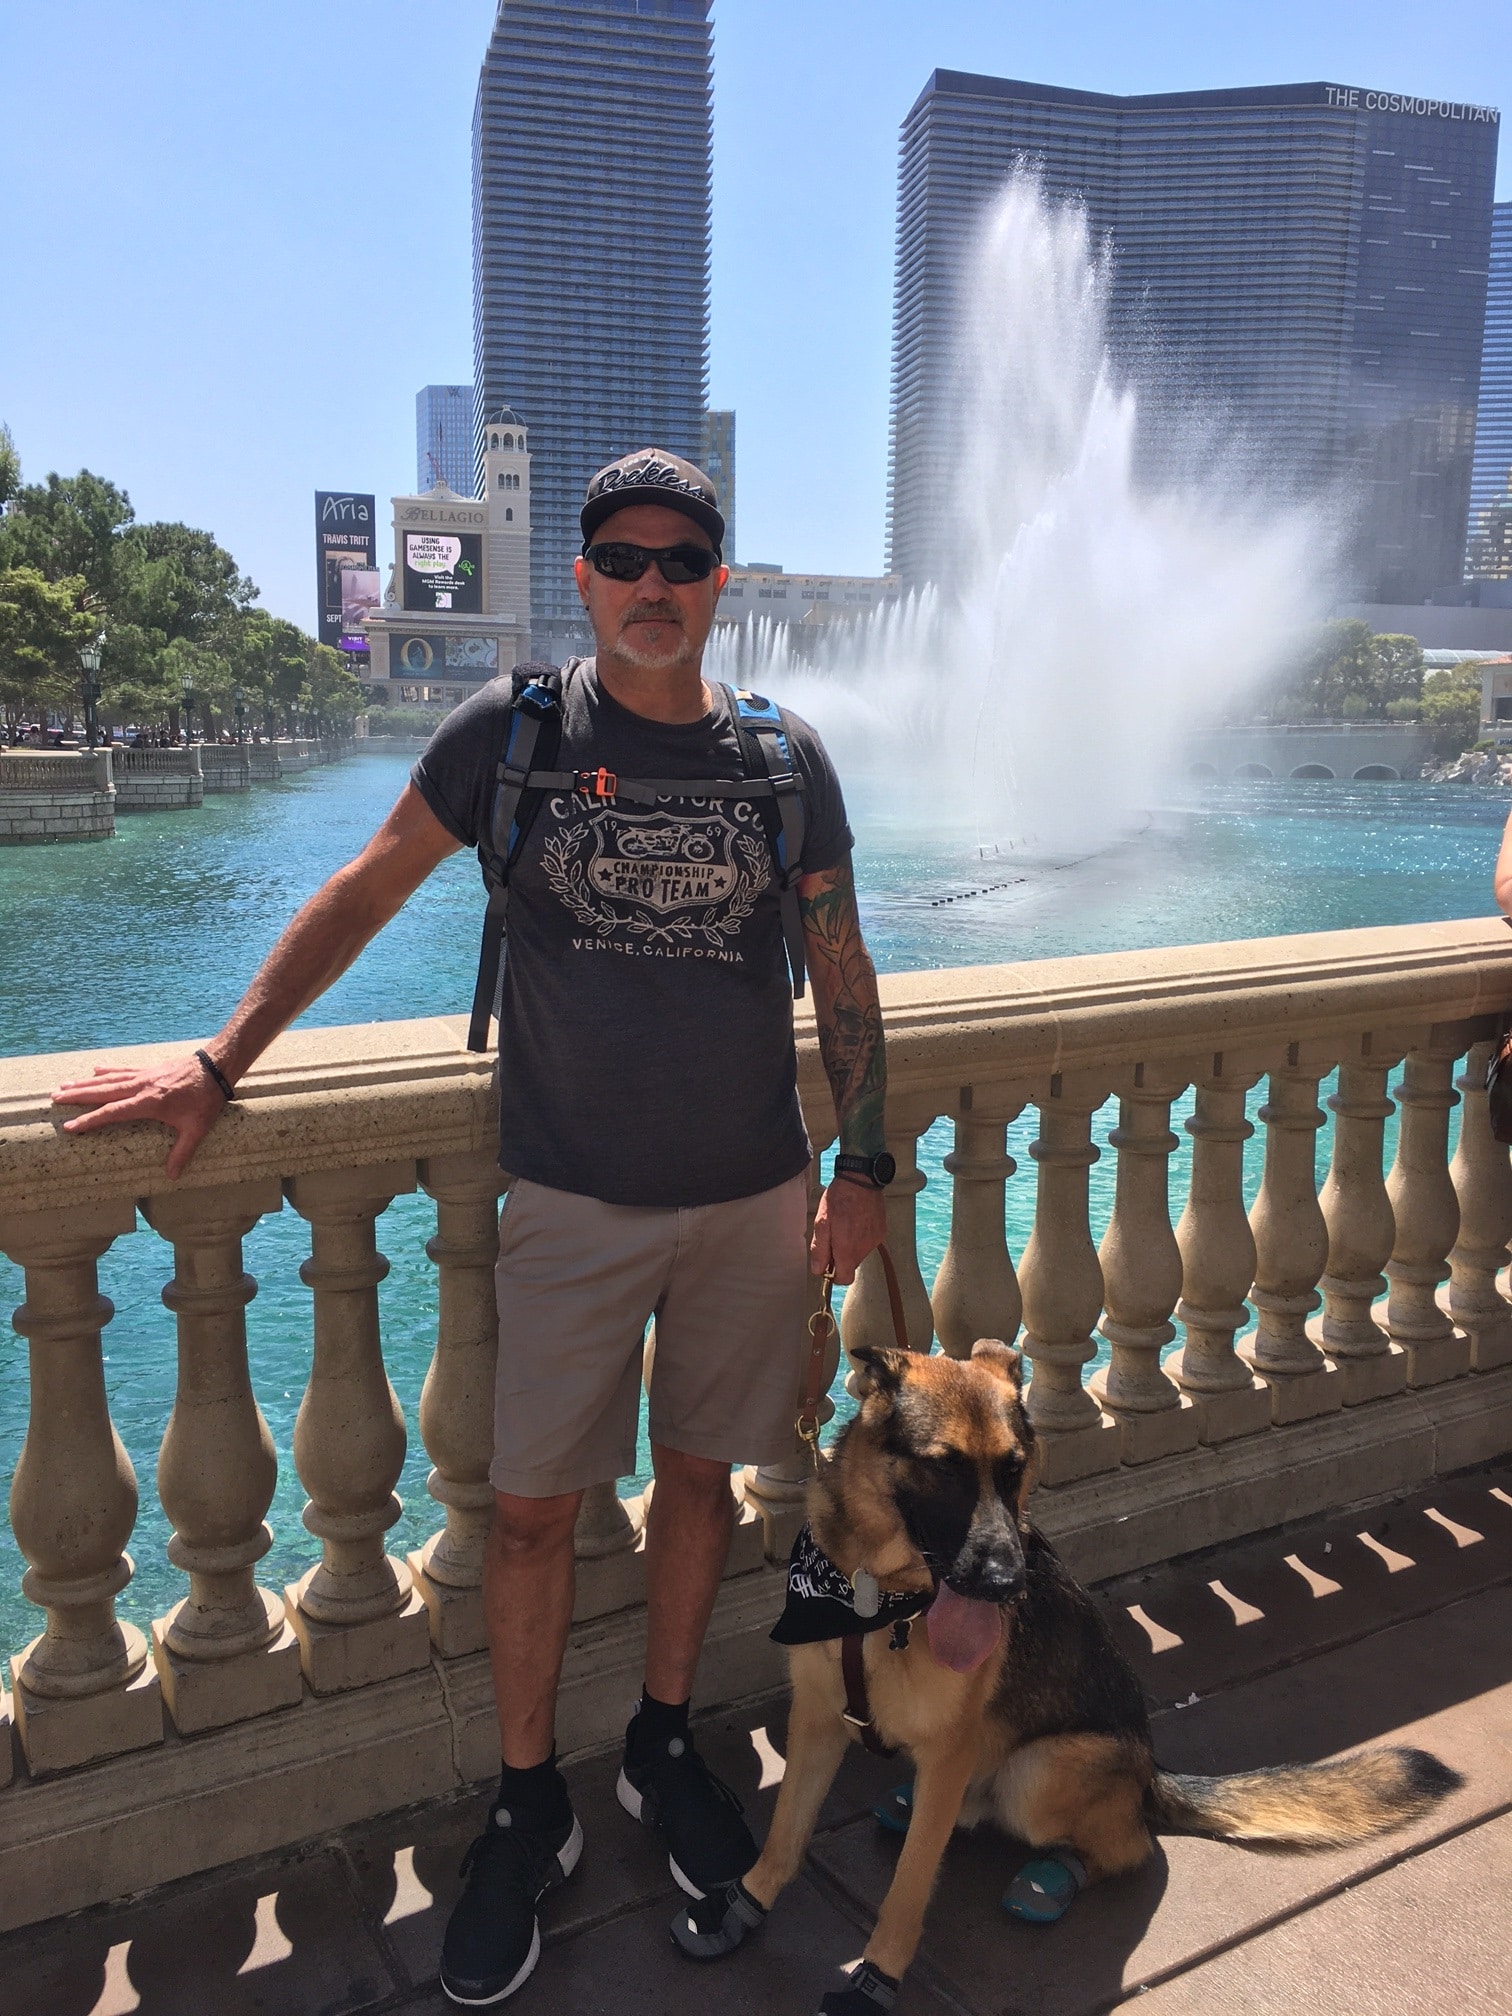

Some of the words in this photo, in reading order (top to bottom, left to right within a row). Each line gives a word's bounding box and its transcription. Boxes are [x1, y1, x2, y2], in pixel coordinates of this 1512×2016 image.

[1325, 87, 1360, 107] THE
[1365, 92, 1499, 124] COSMOPOLITAN
[401, 507, 485, 525] BELLAGIO
[323, 533, 348, 545] TRAVIS
[349, 534, 370, 546] TRITT
[421, 537, 440, 545] USING
[409, 544, 445, 553] GAMESENSE
[446, 546, 453, 554] IS
[412, 552, 436, 560] ALWAYS
[437, 553, 450, 561] THE
[326, 614, 342, 623] SEPT
[603, 820, 618, 832] 19
[706, 825, 721, 837] 69
[613, 861, 715, 880] CHAMPIONSHIP
[615, 877, 654, 899] PRO
[661, 880, 710, 905] TEAM
[643, 945, 744, 962] CALIFORNIA
